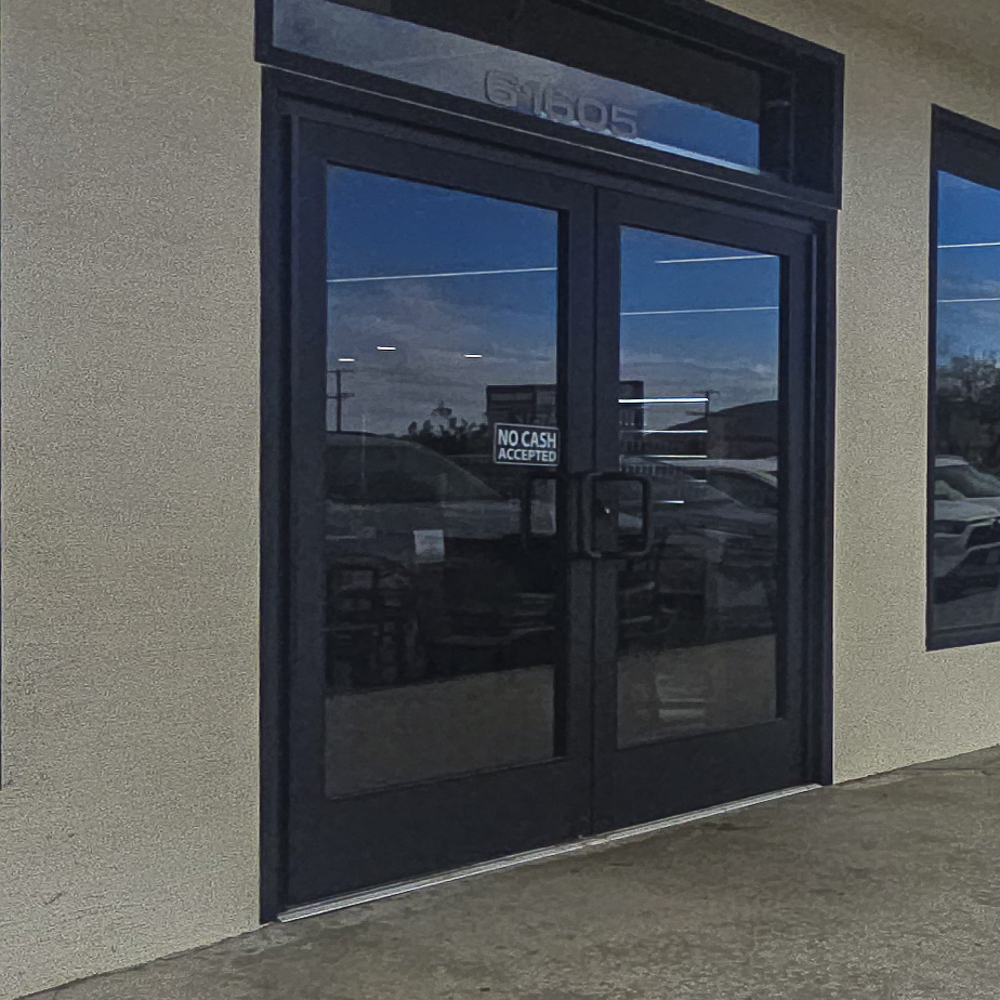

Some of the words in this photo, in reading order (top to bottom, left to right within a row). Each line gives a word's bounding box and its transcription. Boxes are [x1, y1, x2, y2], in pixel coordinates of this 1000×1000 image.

[483, 67, 640, 139] 61605
[498, 428, 519, 447] NO
[520, 430, 557, 449] CASH
[498, 448, 557, 462] ACCEPTED
